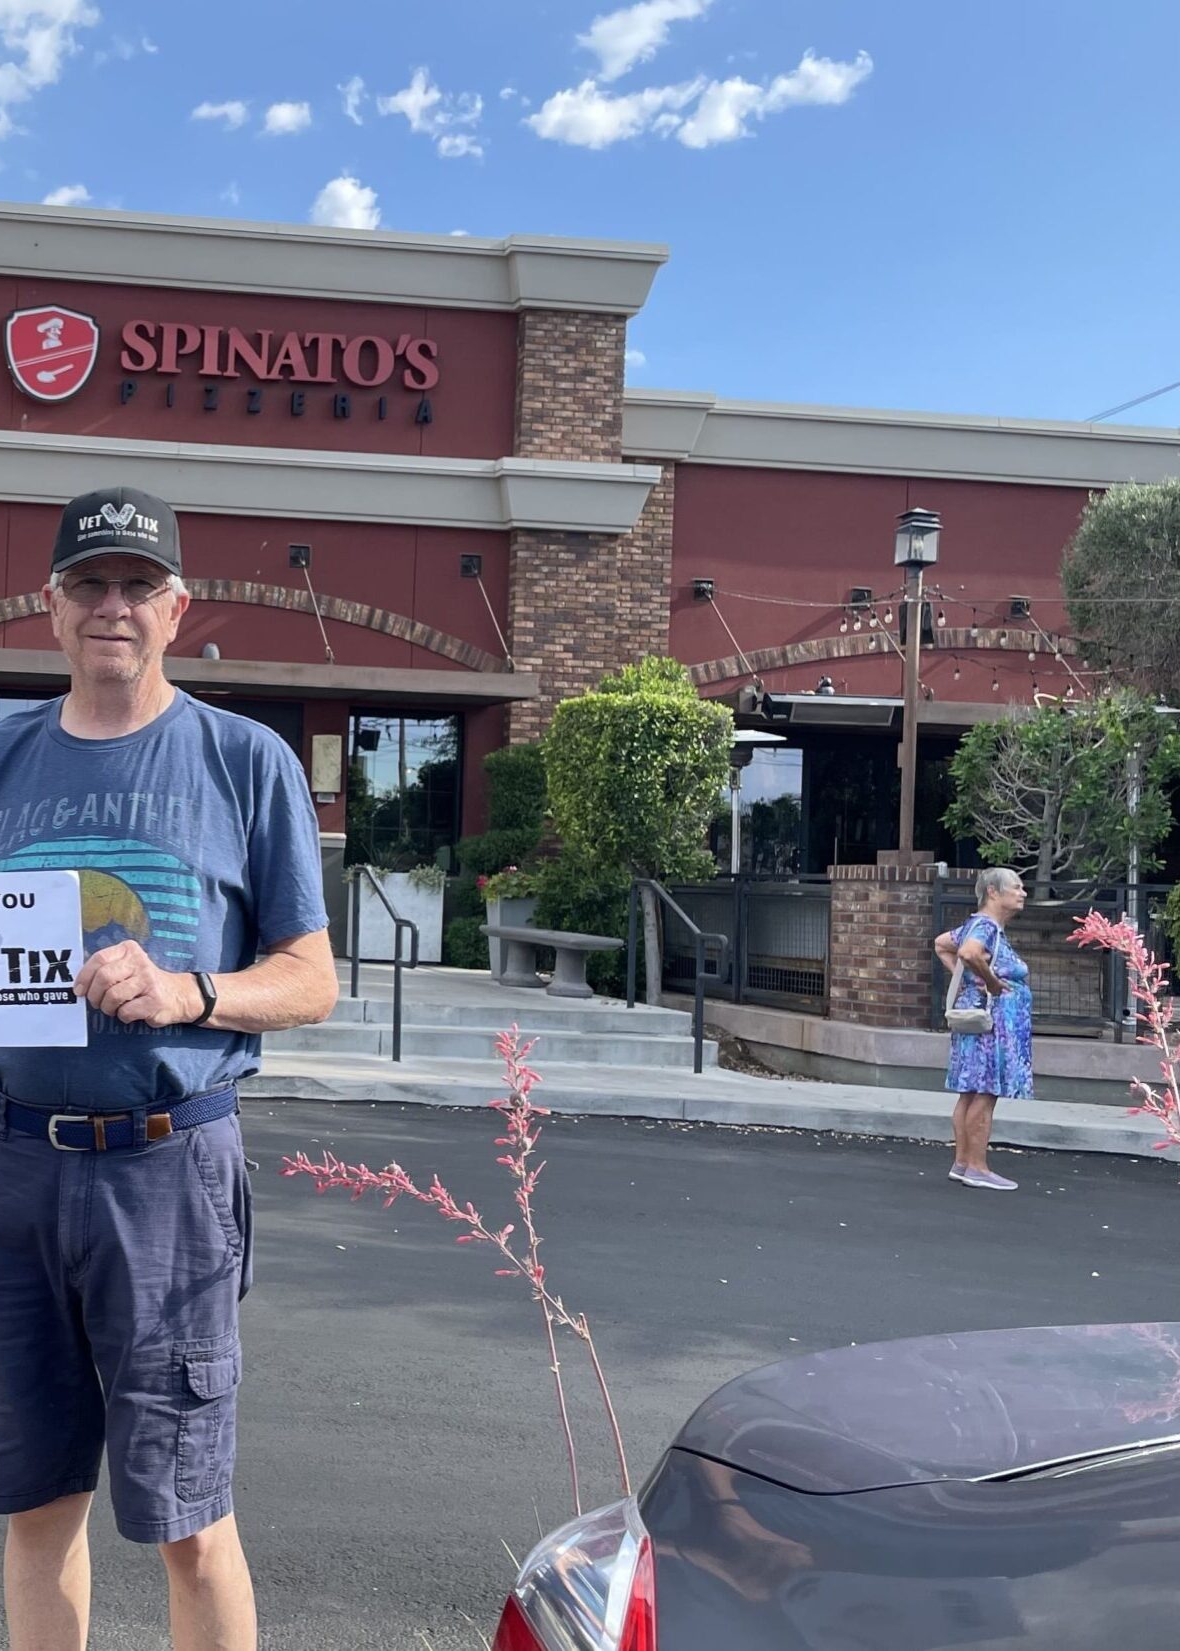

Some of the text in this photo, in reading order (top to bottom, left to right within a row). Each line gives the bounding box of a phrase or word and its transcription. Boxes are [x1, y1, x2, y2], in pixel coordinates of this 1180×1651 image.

[120, 318, 439, 391] SPINATO'S
[121, 379, 433, 424] PIZZERIA
[79, 514, 158, 533] VET TIX
[0, 947, 74, 984] TIX
[18, 991, 40, 1001] who
[43, 992, 69, 1002] gave
